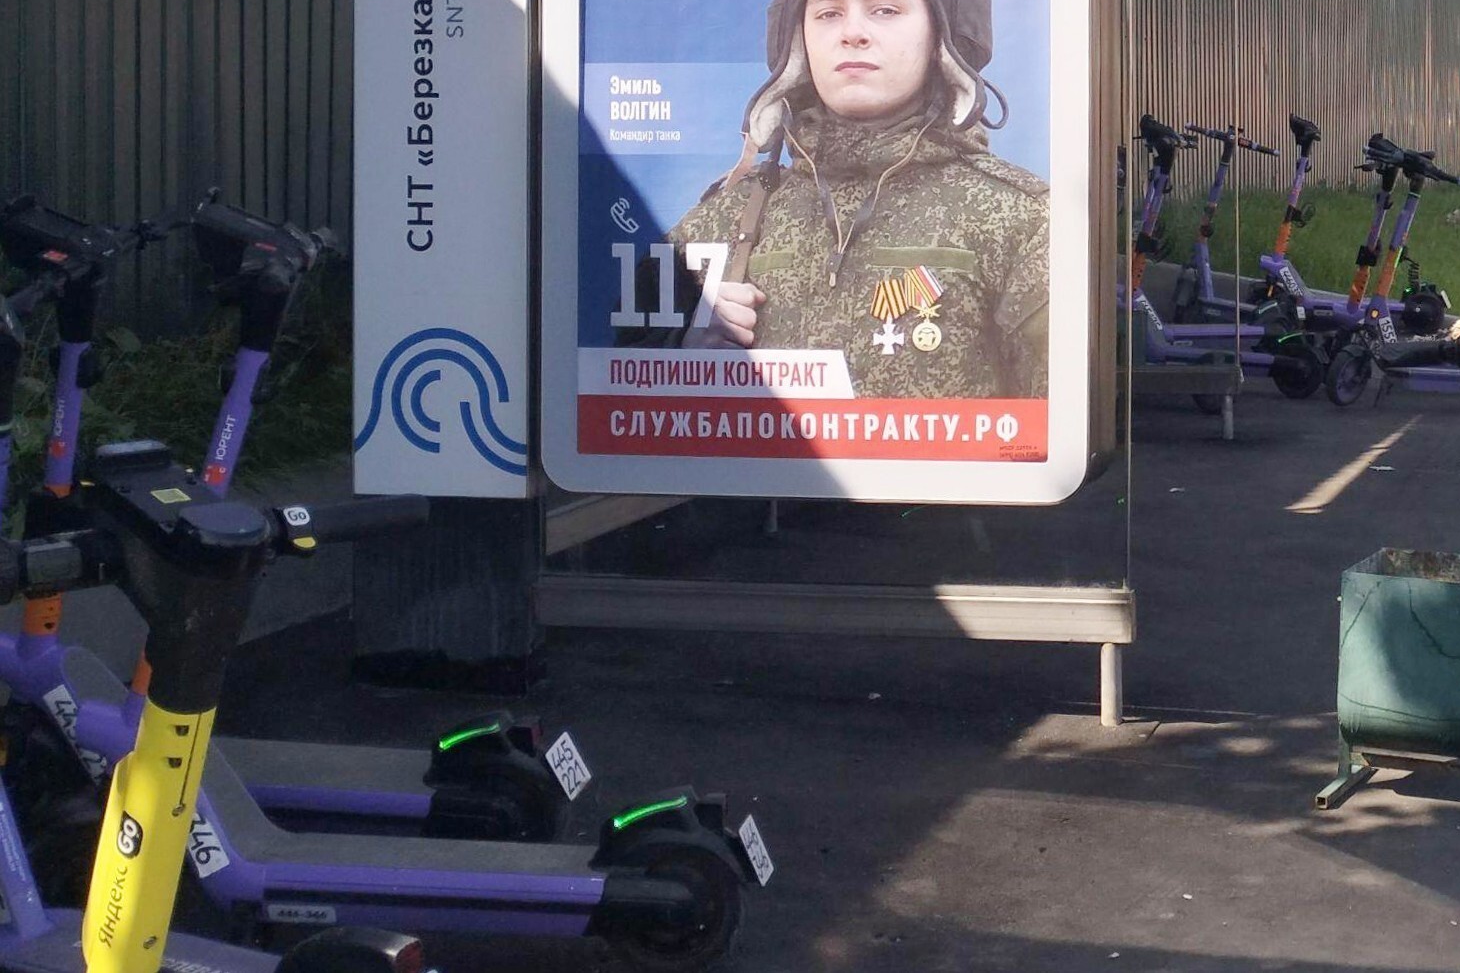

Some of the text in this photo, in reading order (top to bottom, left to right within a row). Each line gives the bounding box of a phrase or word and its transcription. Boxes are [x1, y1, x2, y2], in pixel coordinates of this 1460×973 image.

[609, 75, 662, 95] Эмиль
[610, 101, 671, 120] ВОЛГИН
[609, 129, 681, 144] Командир танка
[406, 175, 434, 252] СНТ
[610, 242, 729, 328] 117
[610, 359, 828, 388] ПОДПИШИ КОНТРАКТ
[215, 414, 237, 461] ЮРЕНТ
[610, 409, 1019, 442] СЛУЖБАПОКОНТРАКТУ.РФ
[98, 866, 129, 948] Яндекс
